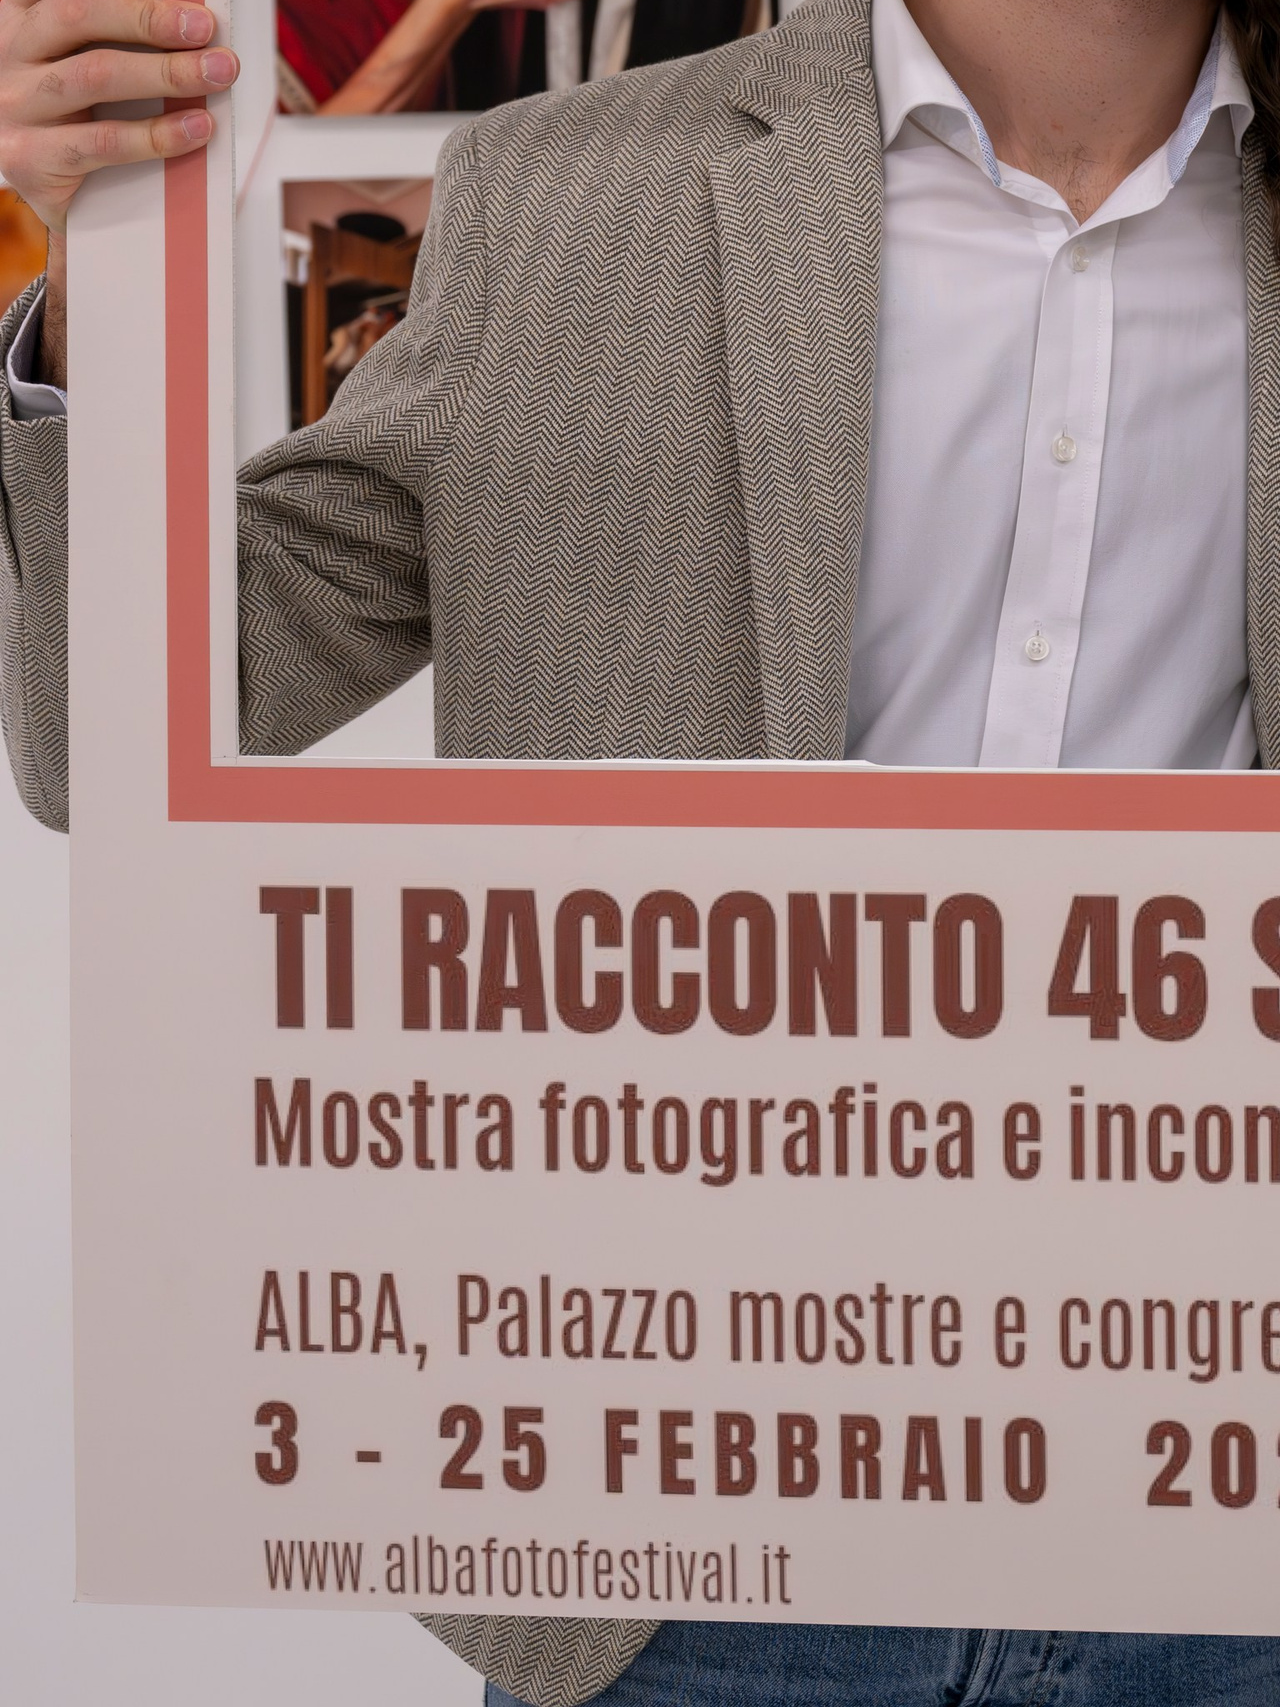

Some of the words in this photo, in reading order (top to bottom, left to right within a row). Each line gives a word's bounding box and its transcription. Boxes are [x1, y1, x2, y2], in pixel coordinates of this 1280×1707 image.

[259, 886, 354, 1029] TI
[402, 888, 1004, 1040] RACCONTO
[1047, 895, 1208, 1042] 46
[254, 1076, 514, 1172] Mostra
[539, 1081, 976, 1188] fotografica
[1002, 1101, 1043, 1181] e
[254, 1270, 428, 1372] ALBA,
[457, 1274, 698, 1363] Palazzo
[729, 1280, 963, 1369] mostre
[994, 1296, 1027, 1369] e
[254, 1400, 299, 1486] 3
[356, 1450, 382, 1463] -
[439, 1404, 547, 1492] 25
[604, 1408, 1048, 1505] FEBBRAIO
[264, 1534, 793, 1606] www.albafotofestival.it
